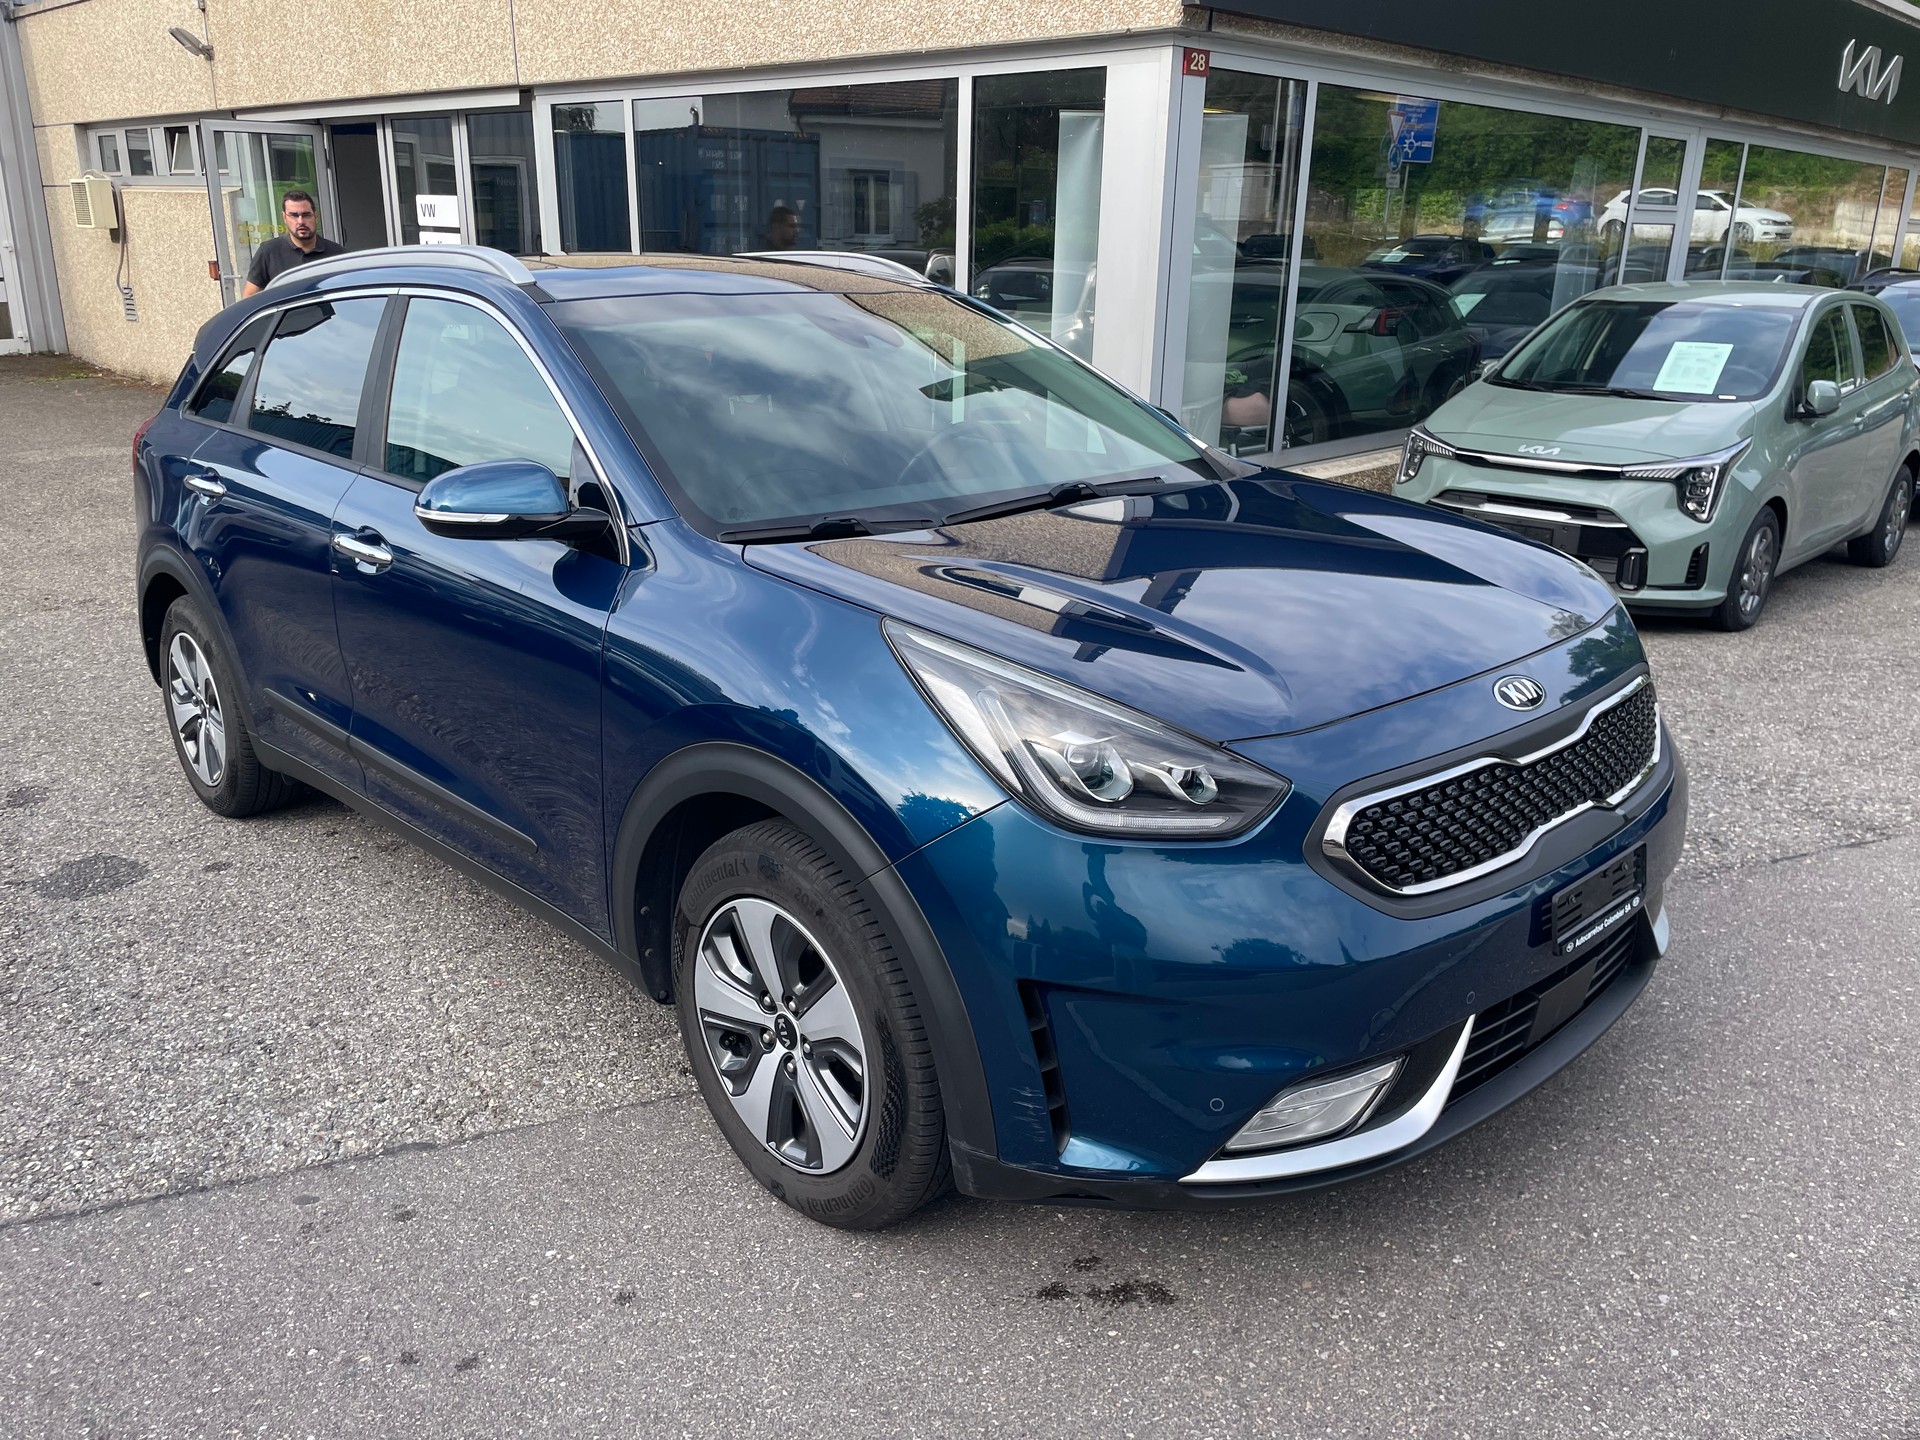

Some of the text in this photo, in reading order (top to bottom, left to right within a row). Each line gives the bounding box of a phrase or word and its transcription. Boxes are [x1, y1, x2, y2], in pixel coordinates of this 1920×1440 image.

[1190, 52, 1206, 71] 28
[420, 203, 436, 218] VW
[1500, 679, 1543, 705] KIA
[685, 857, 740, 913] Continental
[1575, 903, 1631, 947] Autocarrefour Colombier SA
[777, 1018, 791, 1048] KIA
[807, 1172, 876, 1215] Continental
